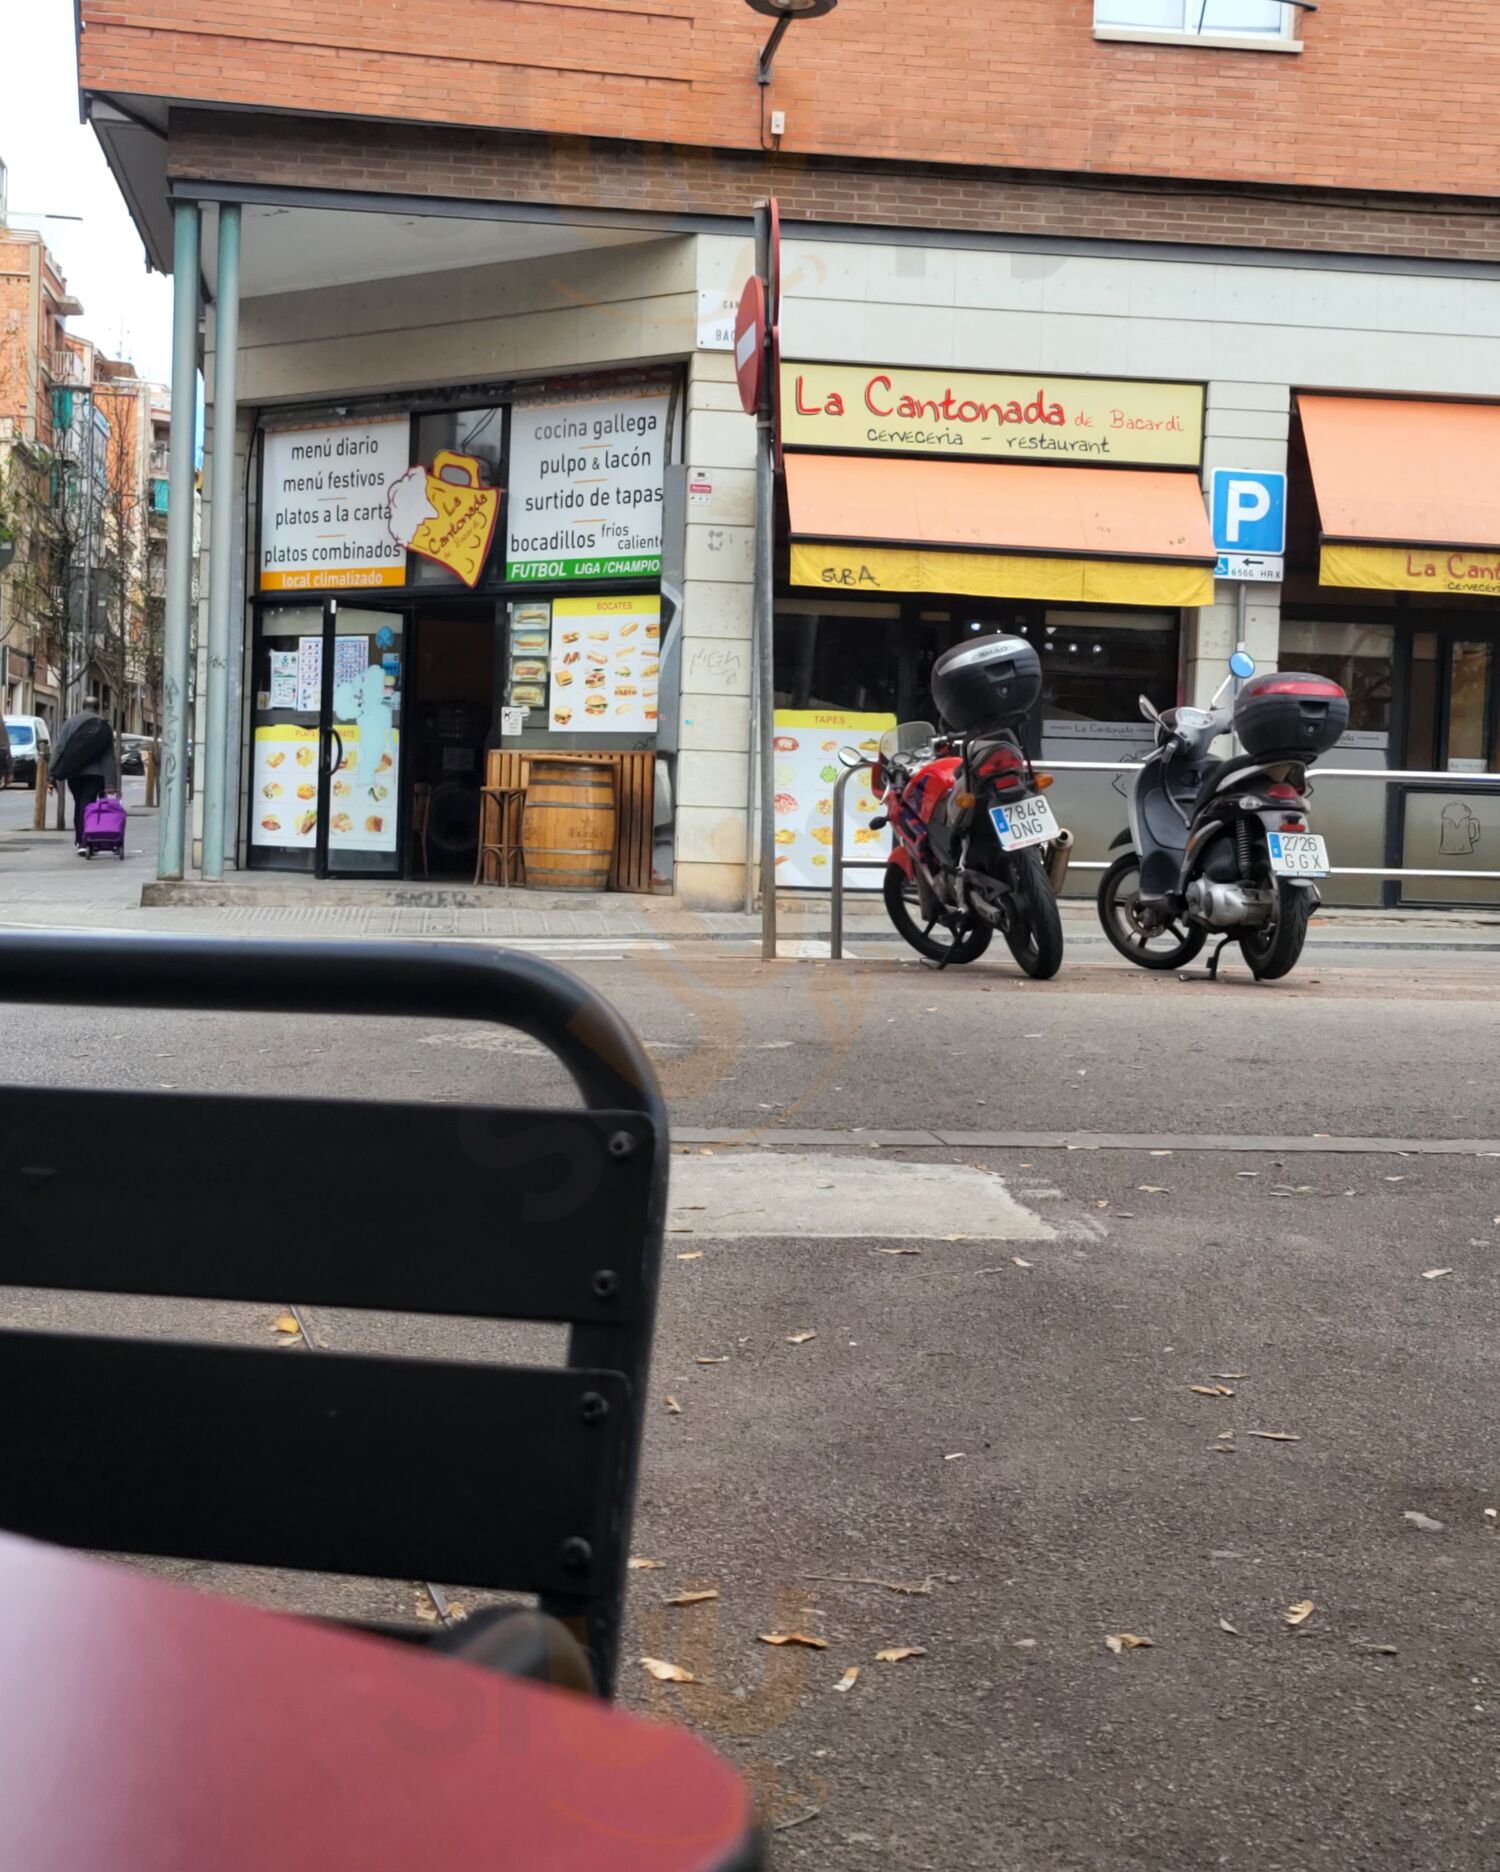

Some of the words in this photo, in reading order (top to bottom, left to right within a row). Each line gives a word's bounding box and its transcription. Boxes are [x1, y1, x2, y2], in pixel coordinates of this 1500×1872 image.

[796, 375, 844, 416] La
[865, 375, 1065, 426] Cantonada
[1074, 410, 1094, 428] de
[1109, 409, 1184, 432] Bacardi
[535, 418, 587, 440] cocina
[593, 413, 657, 439] gallega
[291, 438, 331, 461] menú
[336, 435, 379, 457] diario
[867, 428, 963, 445] cerveceria
[1006, 433, 1110, 454] restaurant
[540, 454, 586, 479] pulpo
[592, 456, 600, 470] &
[605, 446, 651, 469] lacón
[283, 471, 323, 493] menú
[328, 469, 385, 489] festivos
[525, 489, 584, 512] surtido
[590, 487, 609, 506] de
[616, 487, 663, 509] tapas
[1226, 480, 1270, 542] P
[275, 508, 319, 530] platos
[323, 510, 331, 523] a
[336, 504, 349, 522] la
[354, 503, 392, 521] carta
[511, 530, 596, 552] bocadillos
[264, 545, 308, 567] platos
[312, 540, 401, 561] combinados
[1406, 553, 1436, 577] La
[282, 573, 310, 588] local
[314, 571, 383, 586] climatizado
[511, 561, 567, 579] FUTBOL
[575, 562, 600, 575] LIGA
[597, 602, 633, 611] BOCATES
[814, 715, 846, 725] TAPES
[1004, 800, 1047, 823] 7848
[1010, 818, 1043, 840] DNG
[1282, 835, 1318, 852] 2726
[1285, 853, 1322, 870] GGX
